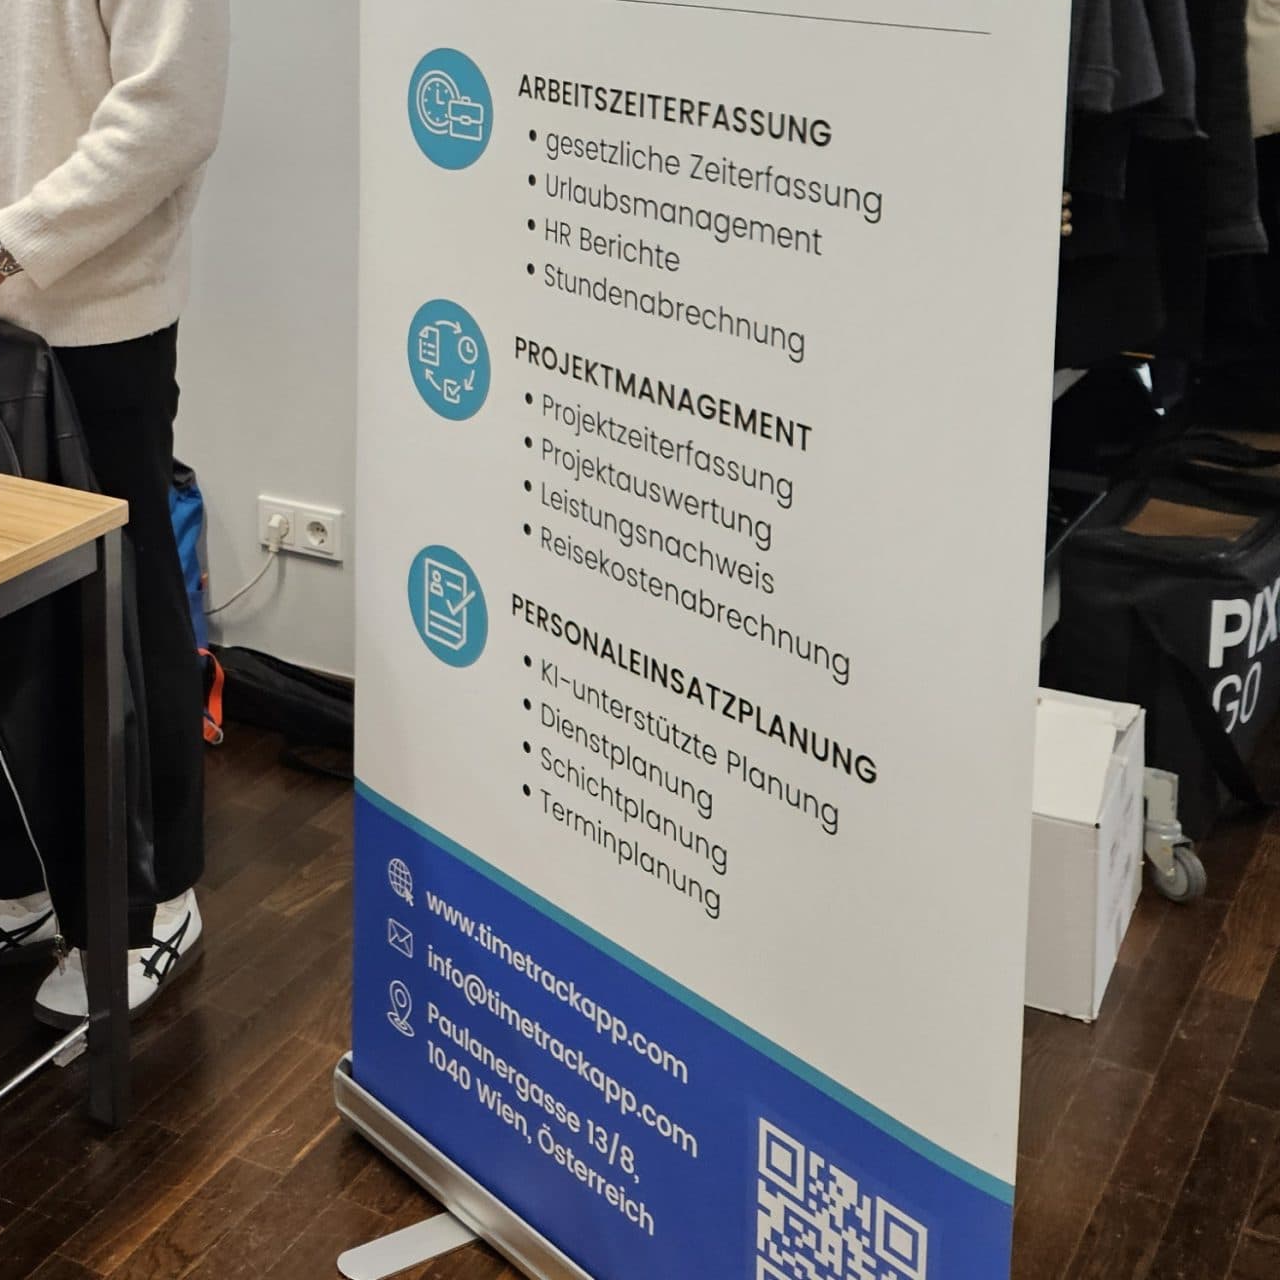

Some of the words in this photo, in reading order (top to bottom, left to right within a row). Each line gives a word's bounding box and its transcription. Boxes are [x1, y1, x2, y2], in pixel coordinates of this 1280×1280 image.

[517, 74, 833, 148] ARBEITSZEITERFASSUNG
[545, 129, 681, 176] gesetzliche
[690, 153, 884, 223] Zeiterfassung
[545, 173, 824, 256] Urlaubsmanagement
[544, 218, 572, 248] HR
[579, 223, 681, 272] Berichte
[543, 263, 806, 363] Stundenabrechnung
[515, 336, 813, 452] PROJEKTMANAGEMENT
[542, 393, 794, 509] Projektzeiterfassung
[541, 438, 773, 551] Projektauswertung
[541, 482, 776, 595] Leistungsnachweis
[541, 526, 851, 686] Reisekostenabrechnung
[511, 593, 878, 785] PERSONALEINSATZPLANUNG
[540, 658, 718, 766] KI-unterstützte
[726, 749, 839, 836] Planung
[540, 702, 714, 820] Dienstplanung
[540, 746, 728, 876] Schichtplanung
[540, 789, 721, 920] Terminplanung
[426, 890, 689, 1084] www.timetrackapp.com
[427, 945, 698, 1159] info@timetrackapp.com
[427, 1002, 581, 1134] Paulanergasse
[586, 1120, 641, 1183] 13/8,
[427, 1040, 472, 1091] 1040
[476, 1077, 533, 1144] Wien,
[538, 1123, 655, 1237] Österreich
